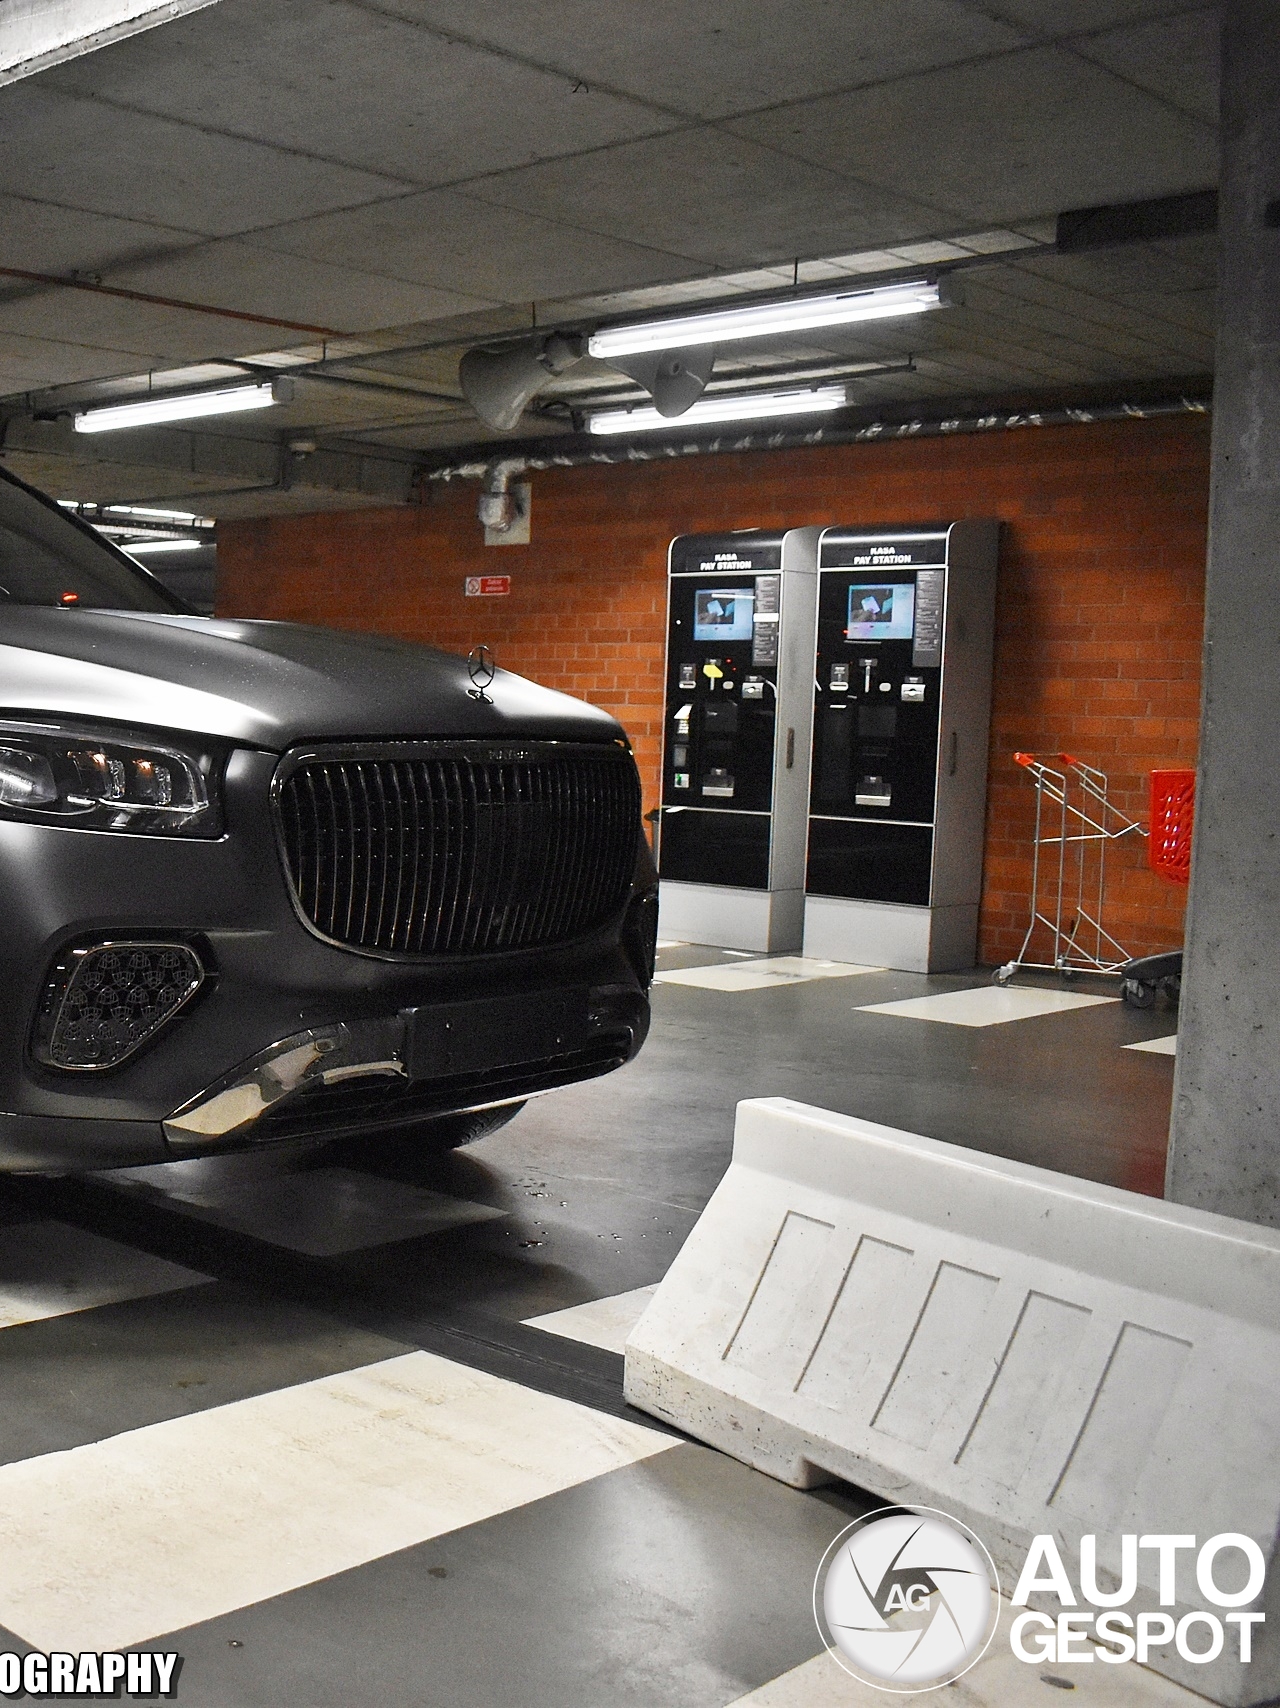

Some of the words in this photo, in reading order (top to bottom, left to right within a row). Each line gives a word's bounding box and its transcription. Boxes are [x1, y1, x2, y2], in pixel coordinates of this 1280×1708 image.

[870, 546, 895, 555] KASA
[853, 556, 871, 565] PAY
[873, 554, 912, 564] STATION
